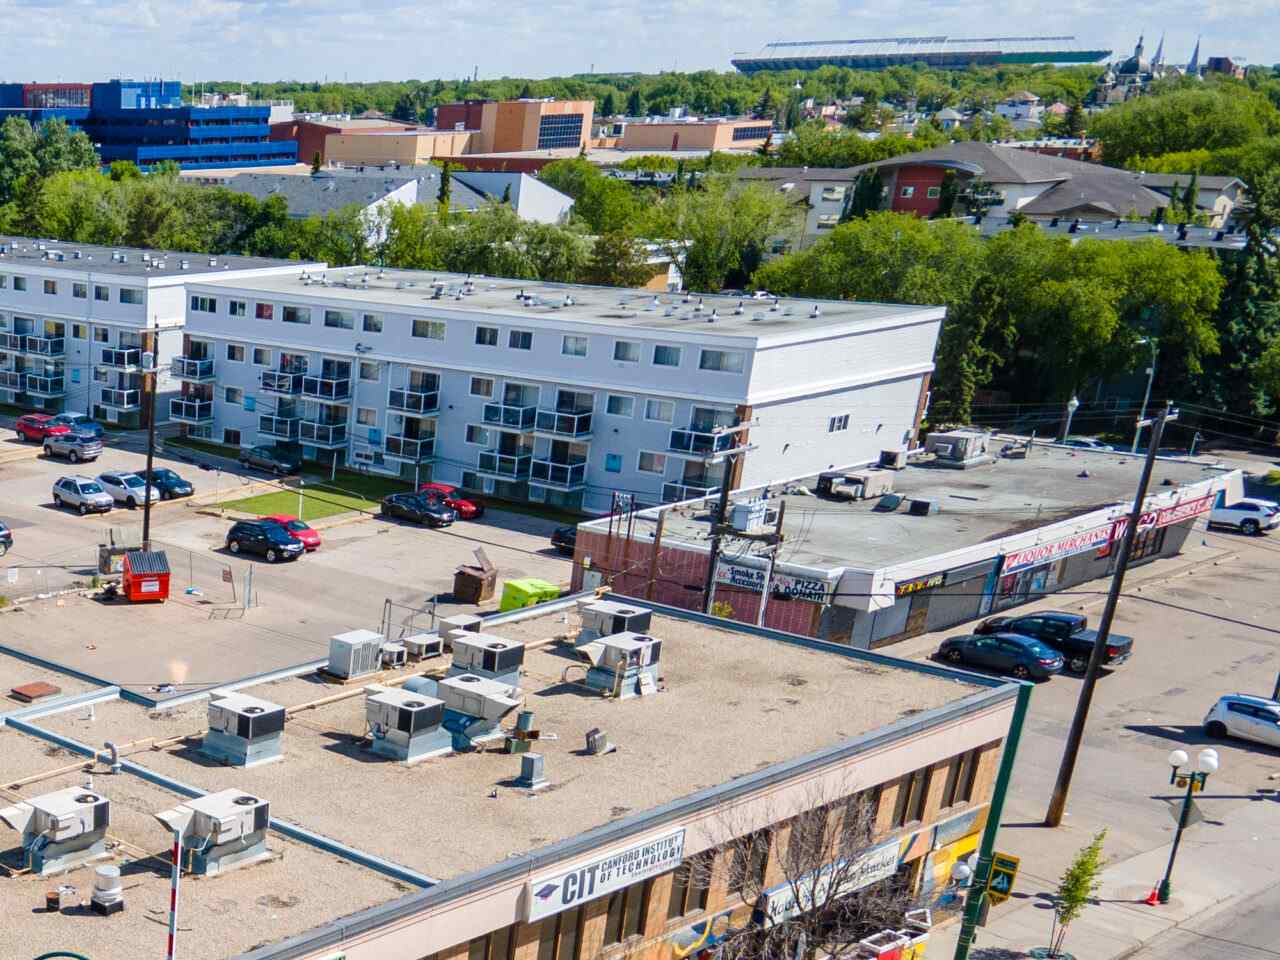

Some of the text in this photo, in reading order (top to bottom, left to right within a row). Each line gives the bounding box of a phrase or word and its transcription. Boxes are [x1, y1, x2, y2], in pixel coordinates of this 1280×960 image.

[794, 580, 825, 592] PIZZA
[600, 868, 612, 883] OF
[561, 864, 601, 905] CIT
